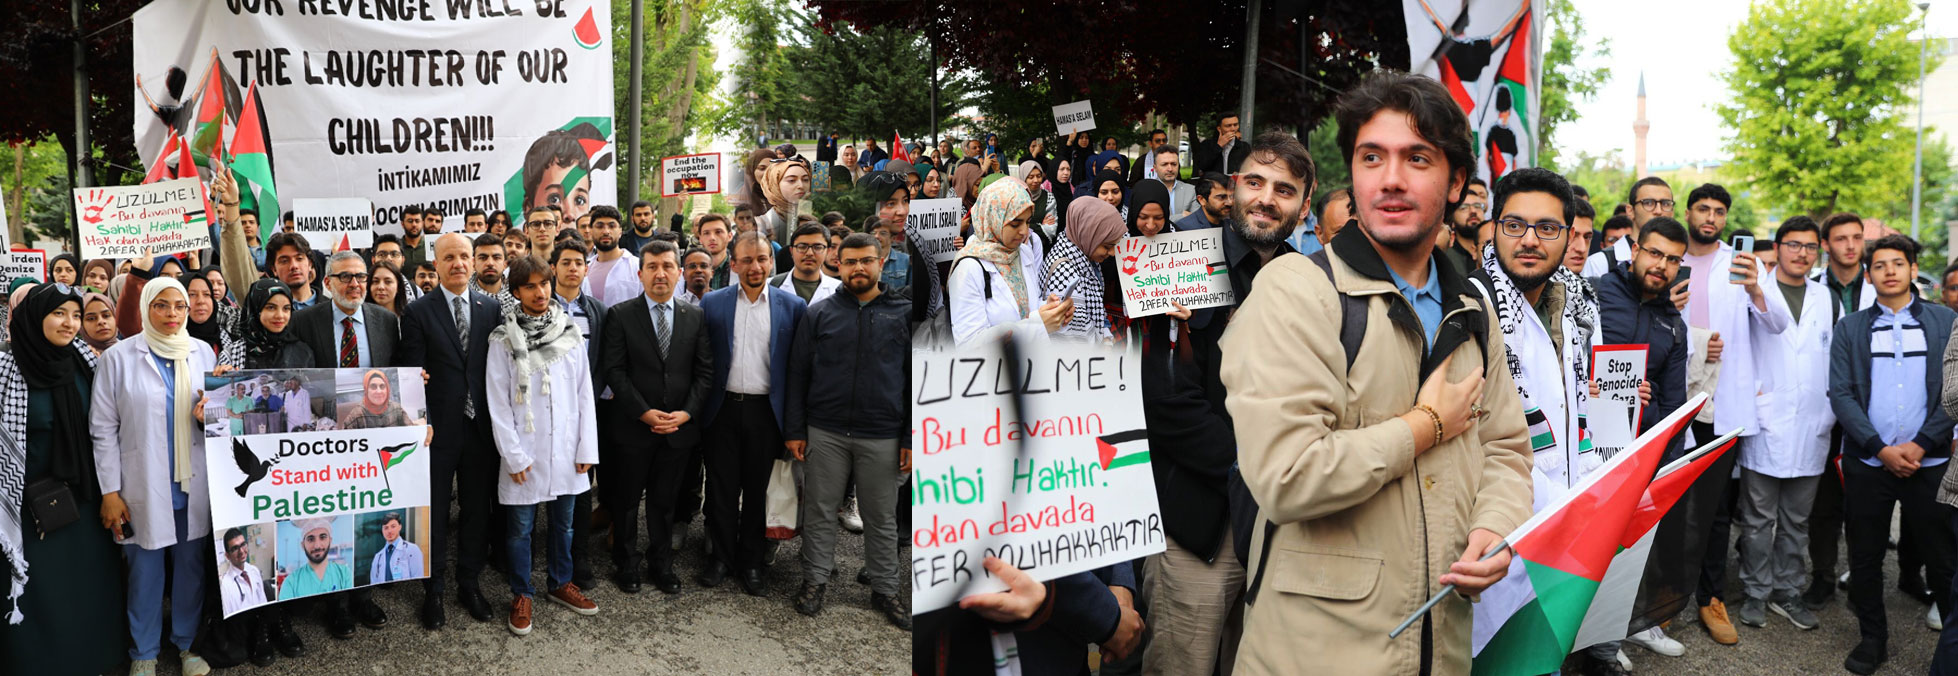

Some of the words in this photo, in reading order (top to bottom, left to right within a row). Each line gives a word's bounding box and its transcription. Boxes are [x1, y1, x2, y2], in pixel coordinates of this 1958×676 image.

[299, 0, 435, 21] REVENGE
[447, 0, 523, 20] WILL
[535, 0, 567, 18] BE
[232, 48, 292, 88] THE
[303, 49, 464, 88] LAUGHTER
[475, 50, 506, 86] OF
[517, 48, 568, 84] OUR
[1075, 110, 1093, 122] SELAM
[328, 116, 494, 155] CHILDREN!!!
[666, 163, 715, 173] occupation
[674, 157, 690, 166] End
[692, 156, 707, 164] the
[378, 162, 481, 192] İNTİKAMIMIZ
[140, 206, 187, 220] davanın
[919, 208, 938, 230] KATİL
[96, 224, 141, 235] Sahibi
[296, 216, 337, 232] HAMAS'A
[340, 215, 370, 231] SELAM
[85, 235, 112, 246] Hak
[141, 231, 182, 245] davada
[1168, 256, 1209, 269] davanın
[1133, 274, 1170, 287] Sahibi
[1126, 288, 1148, 301] Hak
[1171, 283, 1208, 296] davada
[1608, 359, 1632, 376] Stop
[1595, 374, 1643, 391] Genocide
[912, 417, 966, 455] Bu
[279, 437, 369, 458] Doctors
[271, 465, 331, 486] Stand
[336, 462, 378, 480] with
[912, 465, 984, 507] hibi
[253, 485, 393, 520] Palestine
[988, 495, 1096, 536] davada
[912, 548, 973, 594] FER
